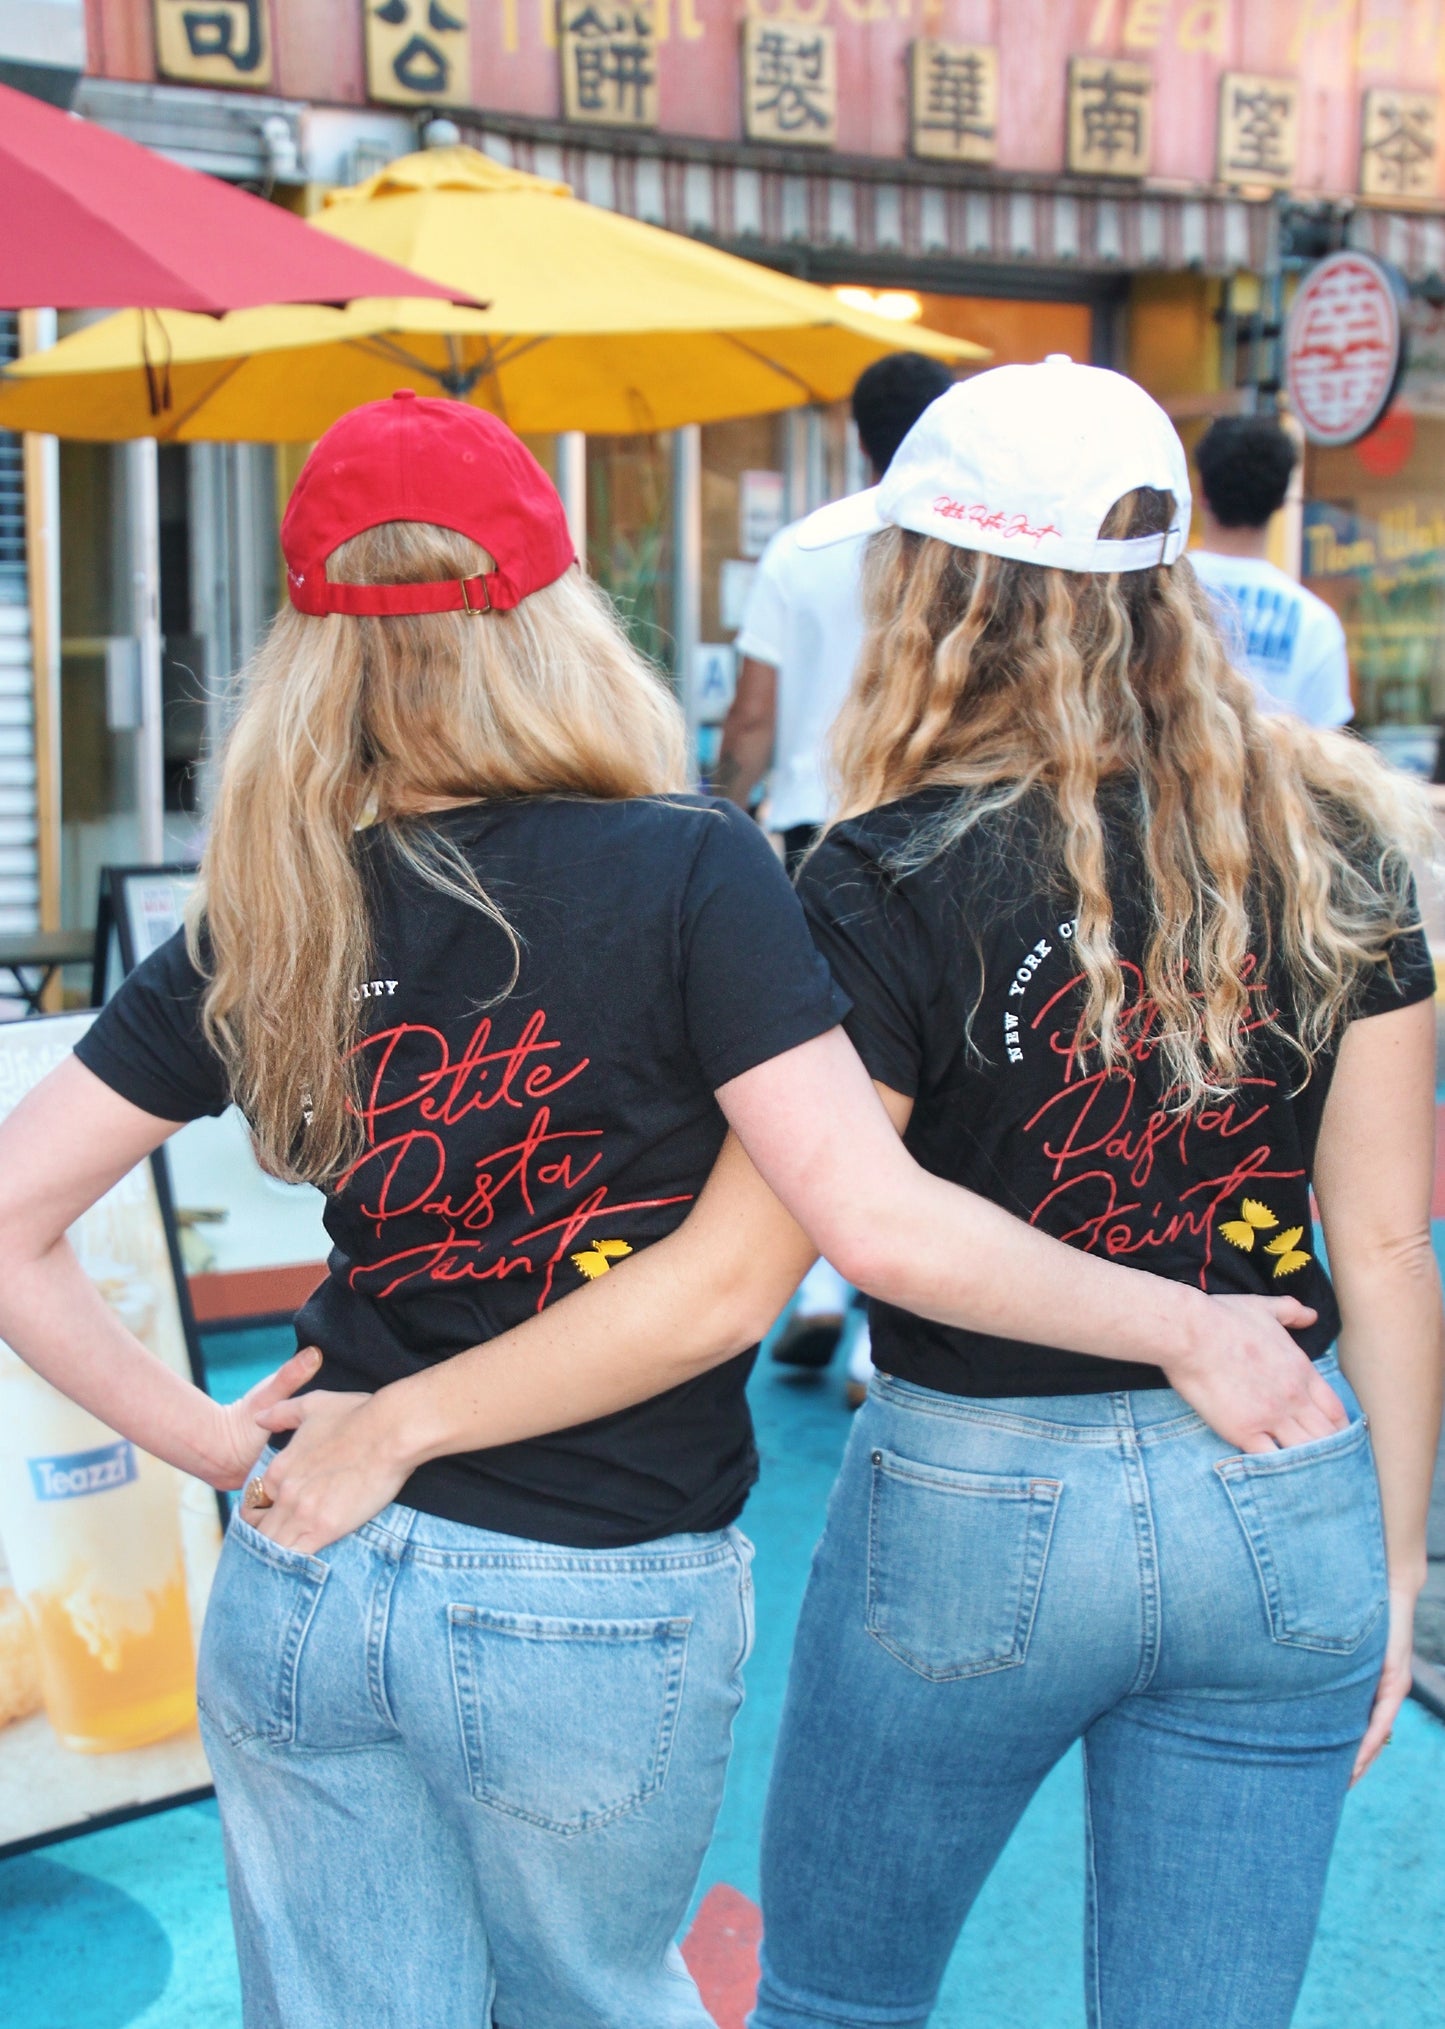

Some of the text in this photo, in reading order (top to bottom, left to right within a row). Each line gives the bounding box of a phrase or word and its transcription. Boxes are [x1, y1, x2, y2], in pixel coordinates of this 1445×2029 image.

[1004, 938, 1053, 1063] NEW YORK
[340, 1009, 590, 1144] Petite
[1024, 1066, 1277, 1187] Pasta
[335, 1105, 604, 1240] Pasta
[37, 1445, 128, 1496] Teazzi
